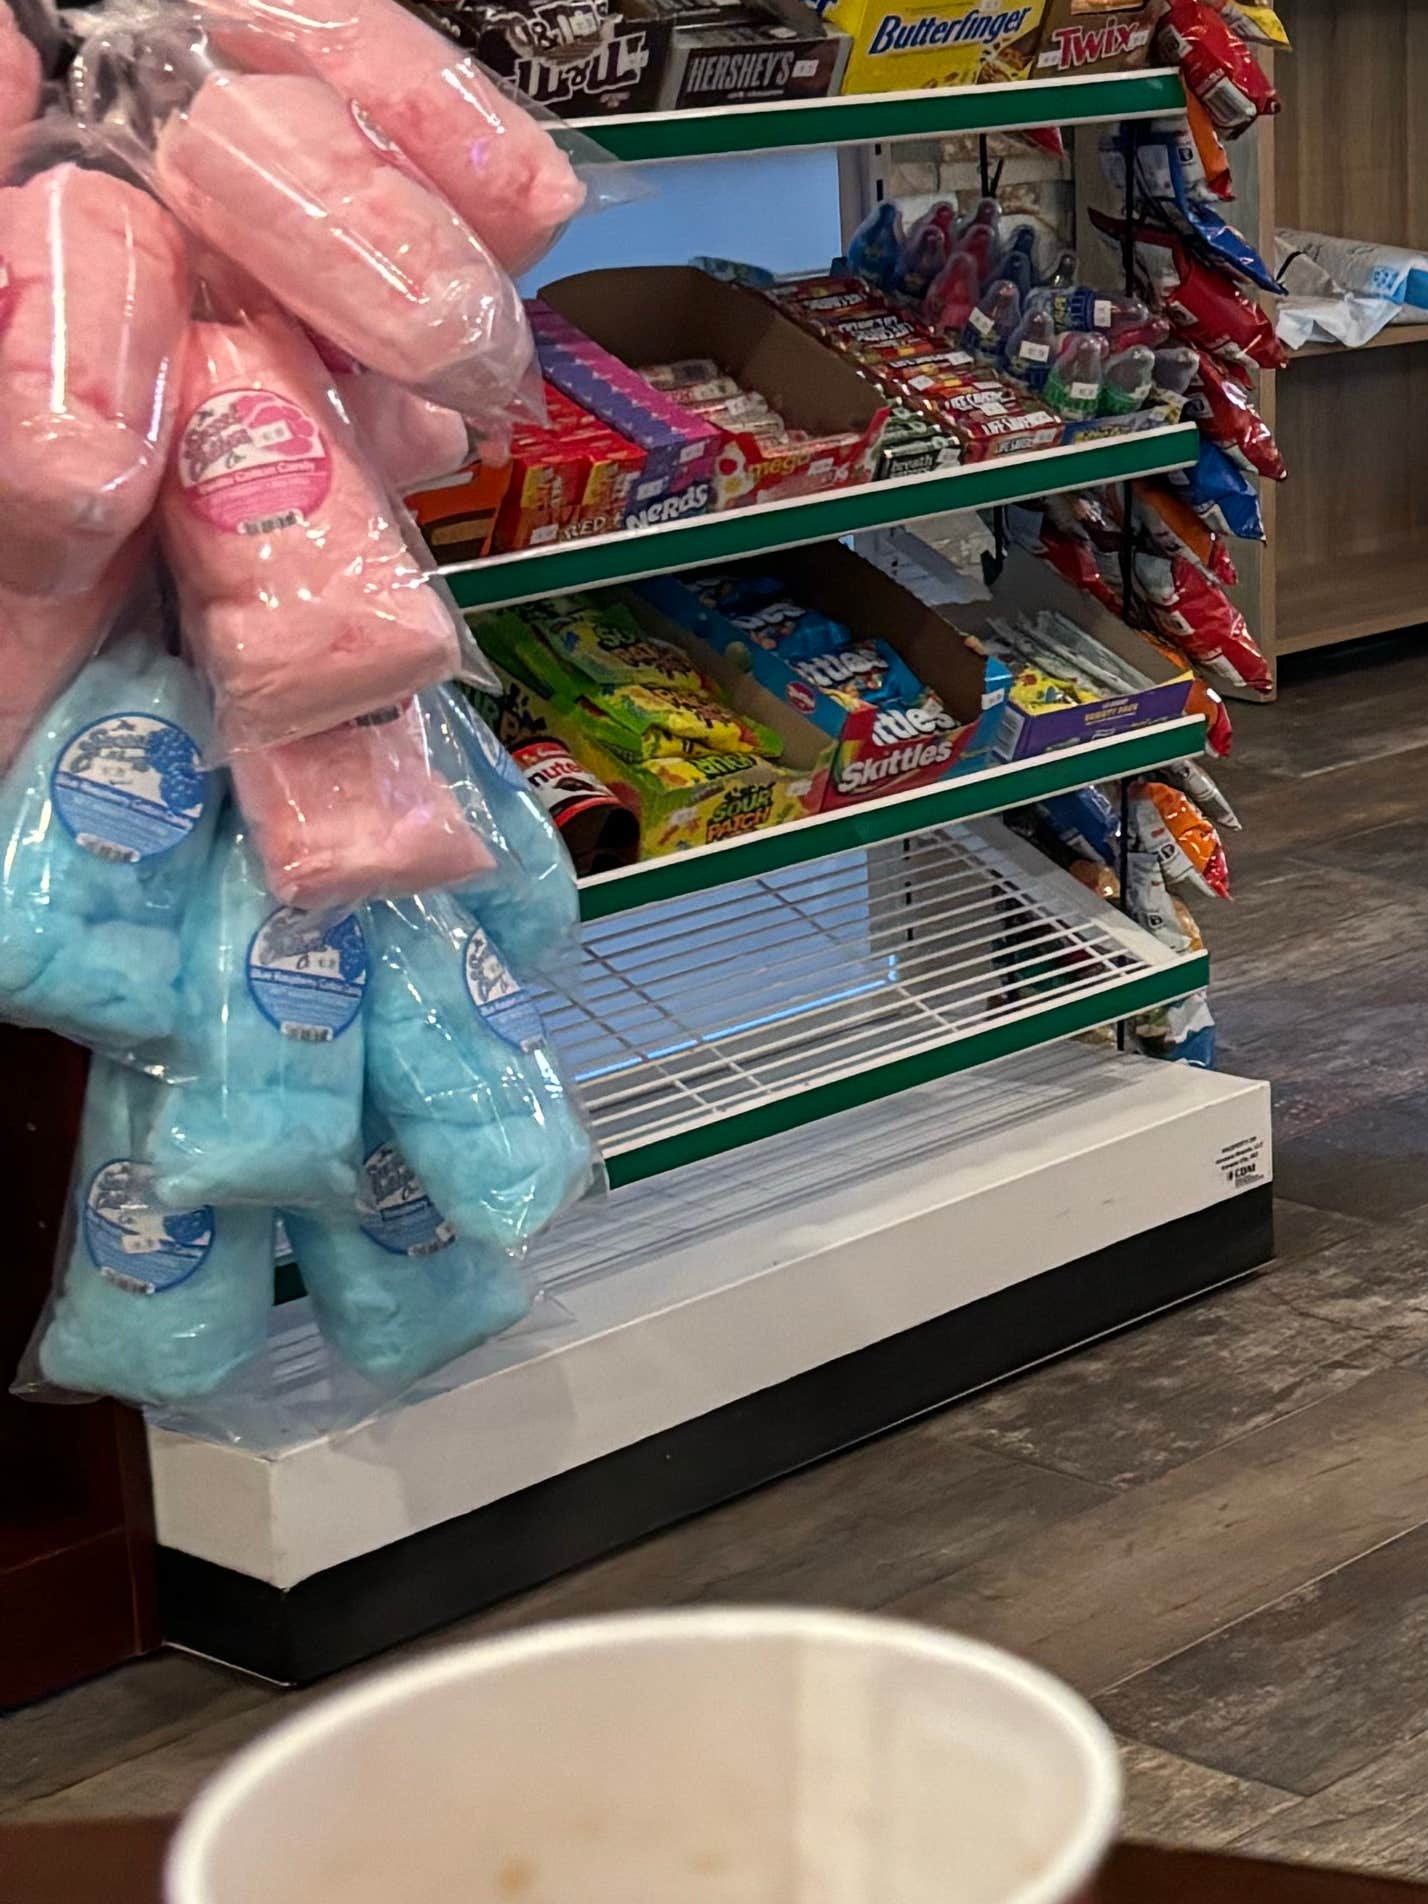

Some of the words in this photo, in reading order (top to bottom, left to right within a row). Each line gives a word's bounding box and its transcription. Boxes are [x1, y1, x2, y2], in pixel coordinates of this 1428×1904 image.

[868, 6, 1032, 56] Butterfinger
[686, 50, 795, 93] HERSHEY'S
[837, 741, 953, 794] Skittles
[707, 807, 771, 843] PATCH
[712, 787, 772, 820] SOUR
